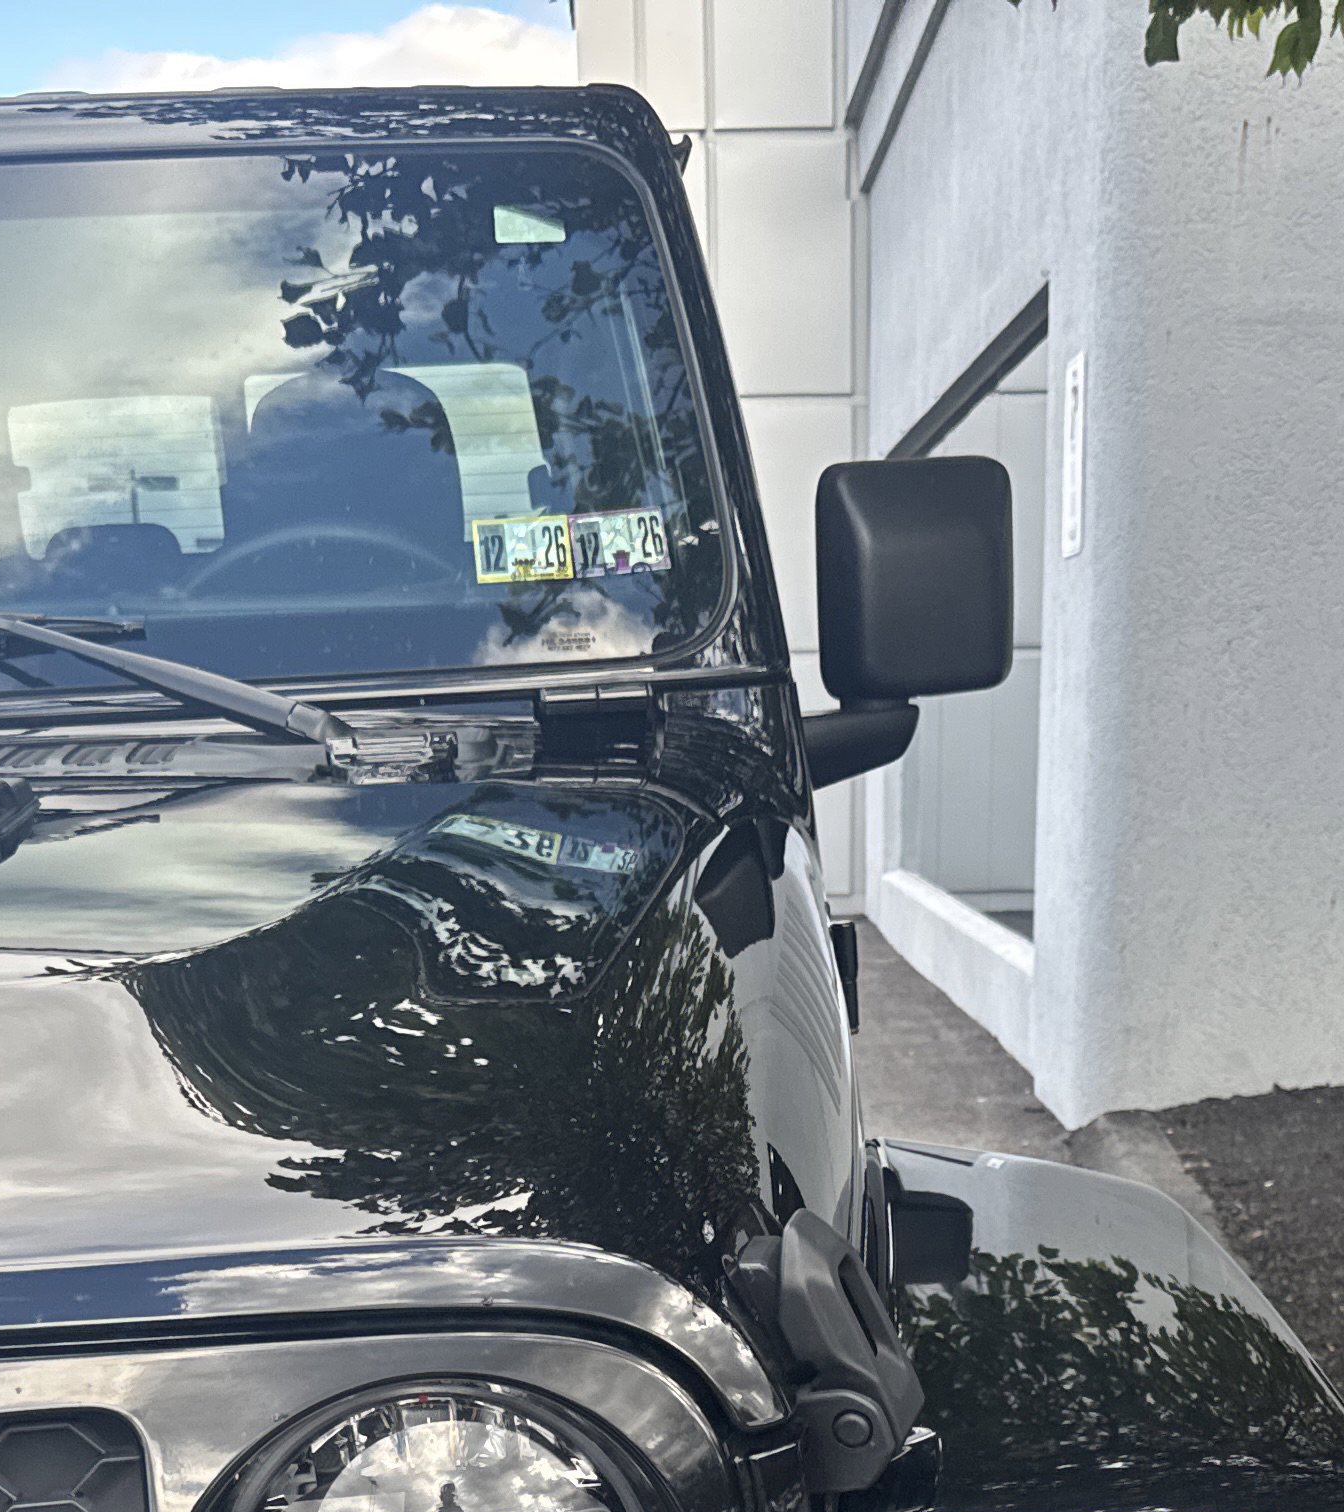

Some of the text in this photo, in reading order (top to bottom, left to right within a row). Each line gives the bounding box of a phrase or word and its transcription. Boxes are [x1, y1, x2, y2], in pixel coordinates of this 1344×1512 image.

[480, 525, 567, 573] 12 26
[637, 515, 664, 558] 26
